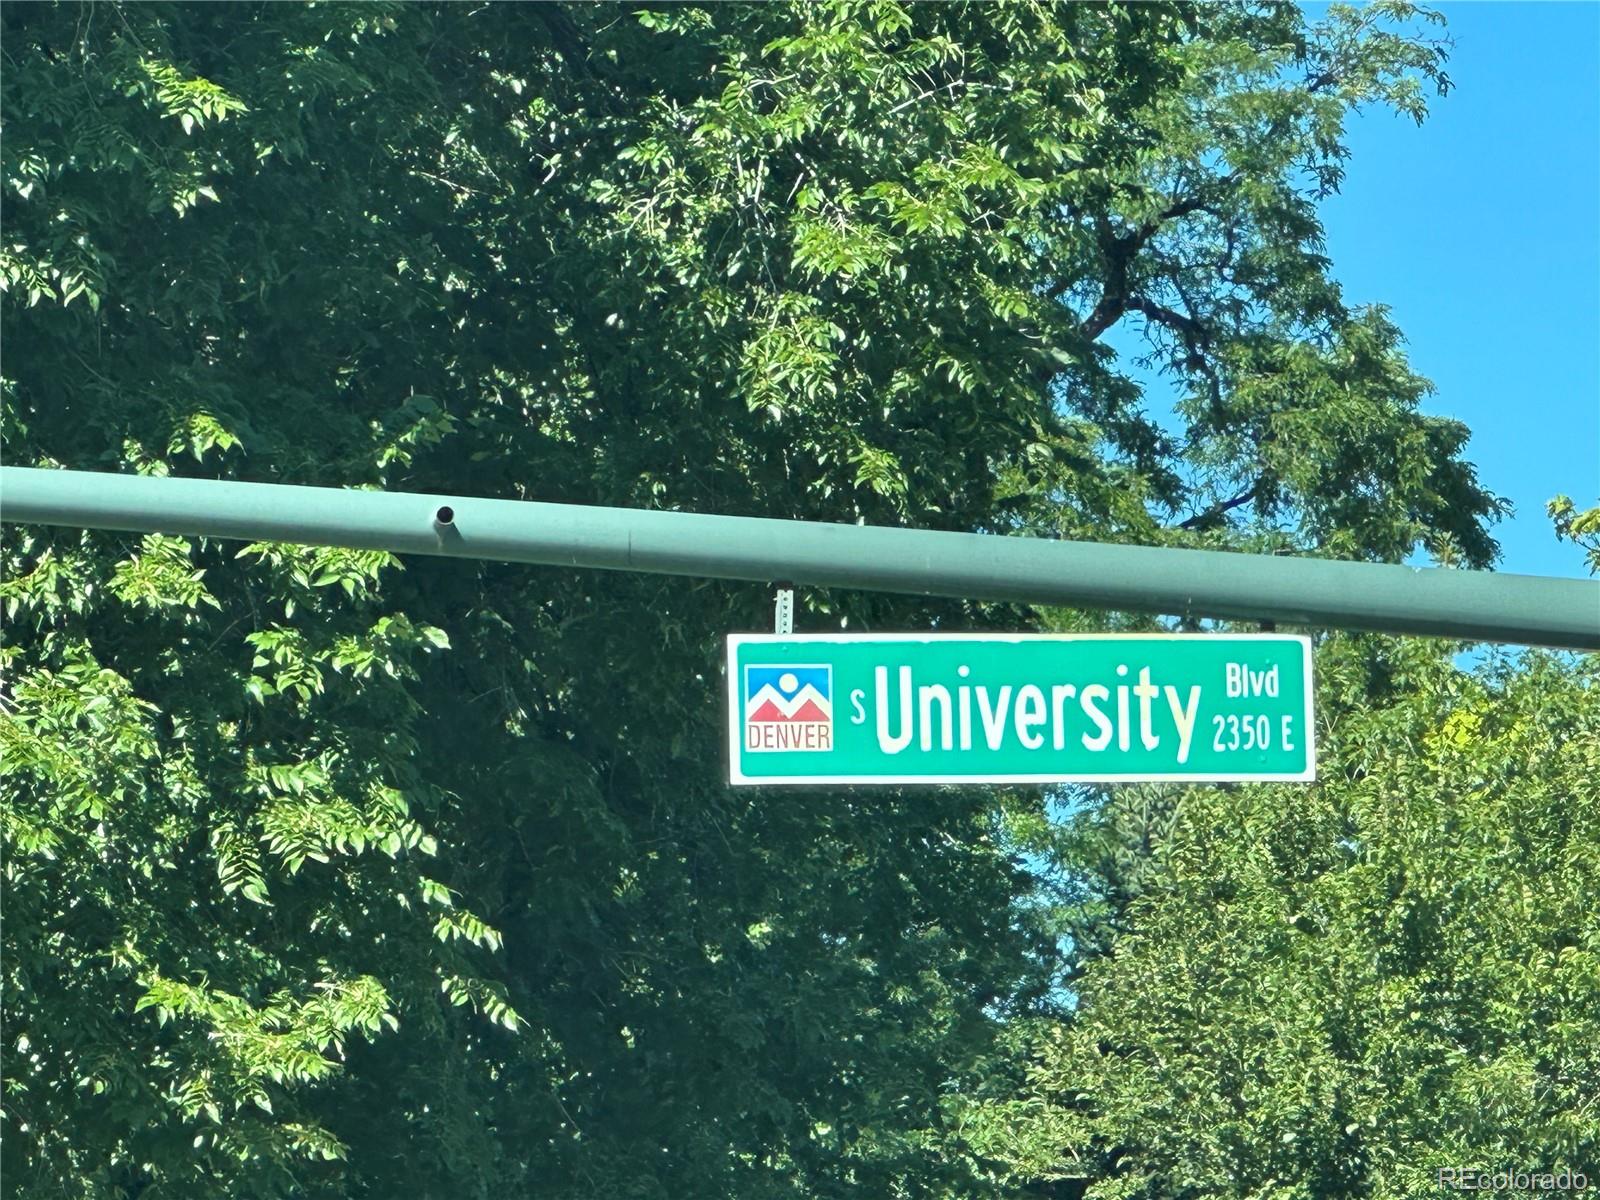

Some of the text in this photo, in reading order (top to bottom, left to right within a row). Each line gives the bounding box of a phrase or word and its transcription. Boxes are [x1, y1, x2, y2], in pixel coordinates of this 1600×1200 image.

[850, 662, 1280, 764] S University Blvd
[748, 724, 831, 749] DENVER
[1212, 714, 1295, 752] 2350 E
